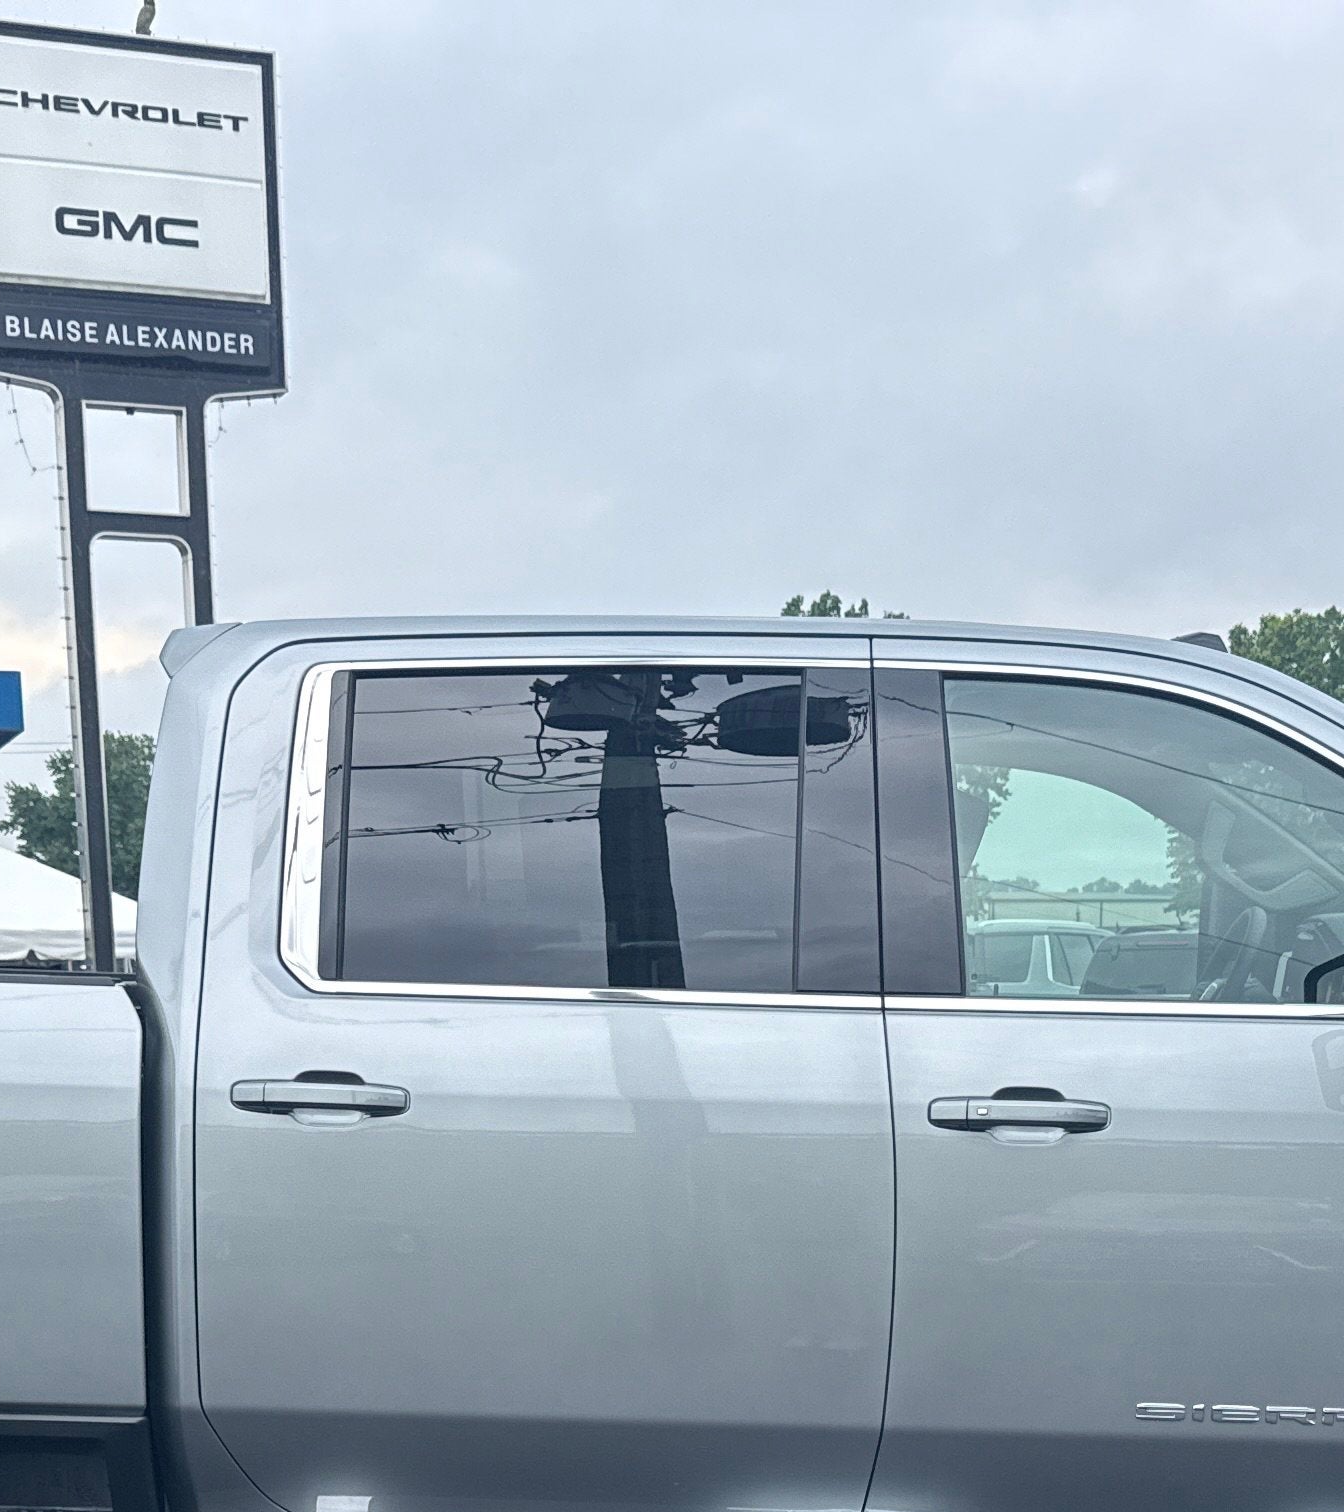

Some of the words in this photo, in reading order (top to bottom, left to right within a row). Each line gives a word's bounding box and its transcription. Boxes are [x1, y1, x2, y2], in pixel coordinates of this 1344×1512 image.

[55, 205, 200, 249] GMC
[5, 314, 100, 344] BLAISE
[105, 323, 255, 356] ALEXANDER
